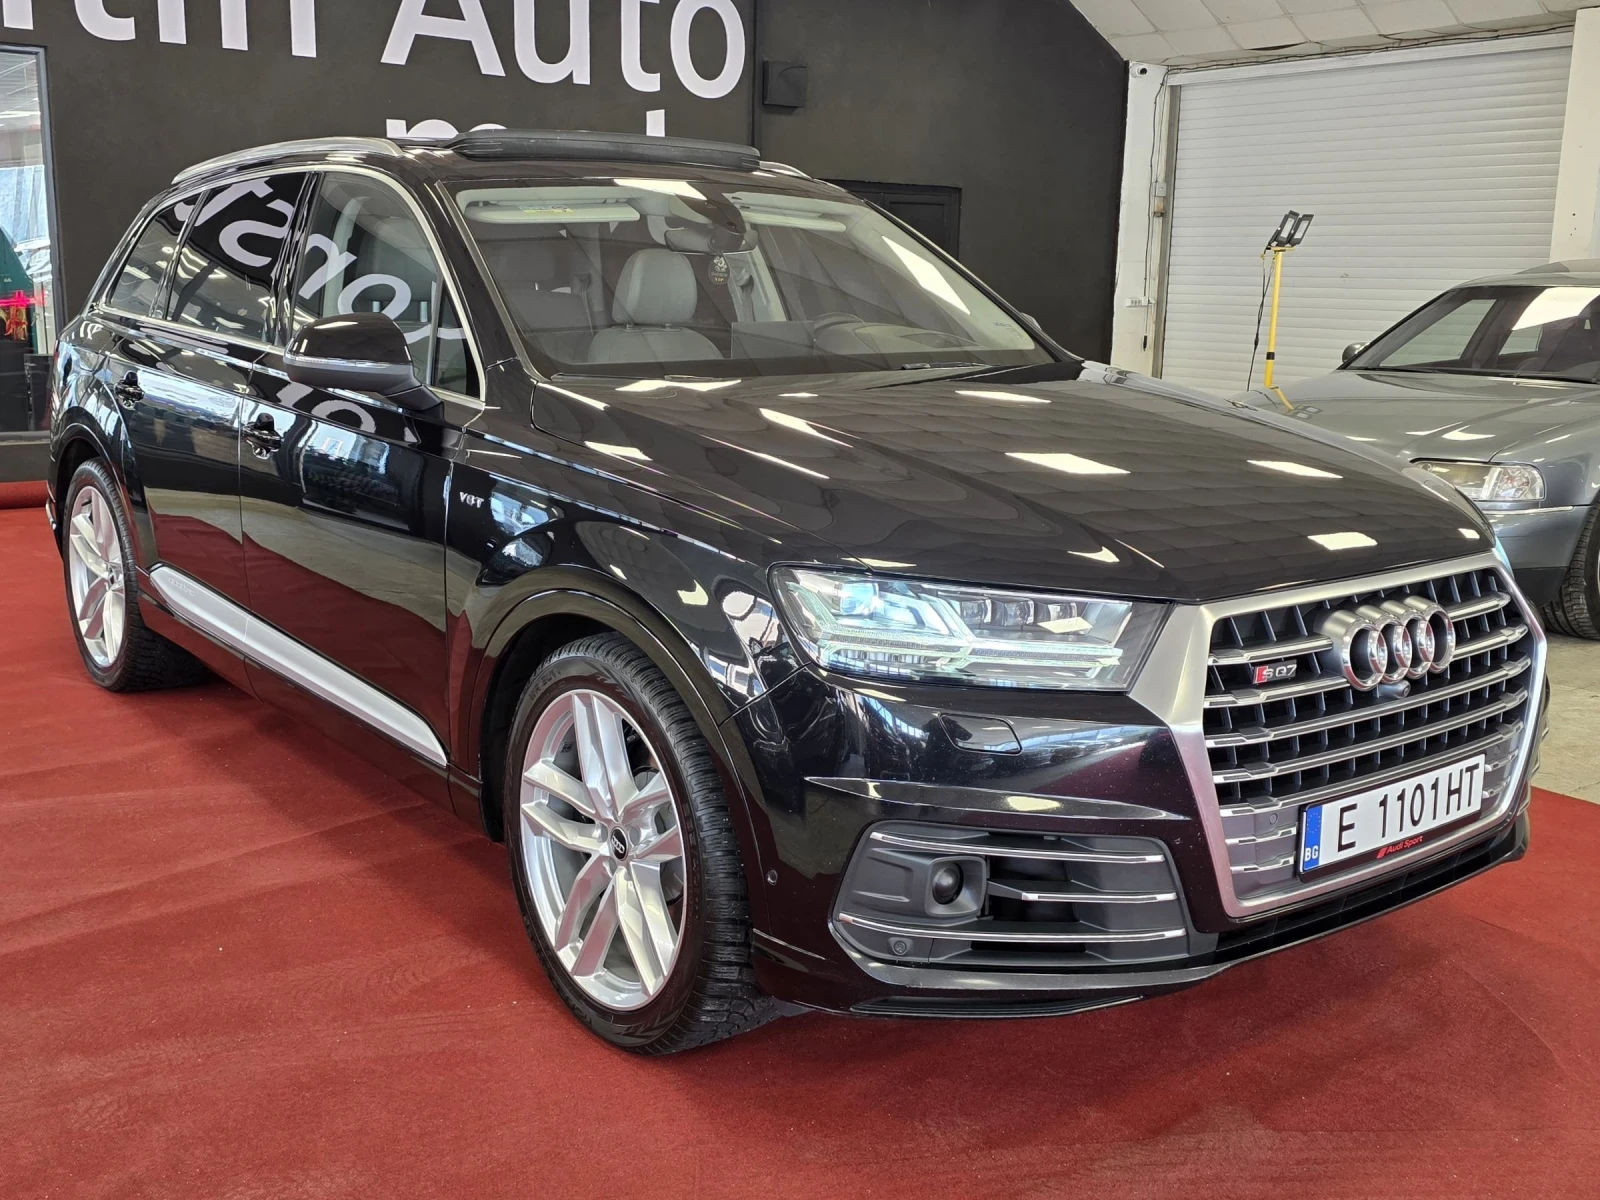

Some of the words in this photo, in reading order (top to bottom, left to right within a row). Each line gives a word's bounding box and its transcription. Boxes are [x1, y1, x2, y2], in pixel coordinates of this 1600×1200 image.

[381, 0, 745, 99] Auto
[1338, 803, 1358, 852] E
[1386, 841, 1404, 854] Audi
[1403, 834, 1424, 848] Sport
[1304, 845, 1319, 862] BG
